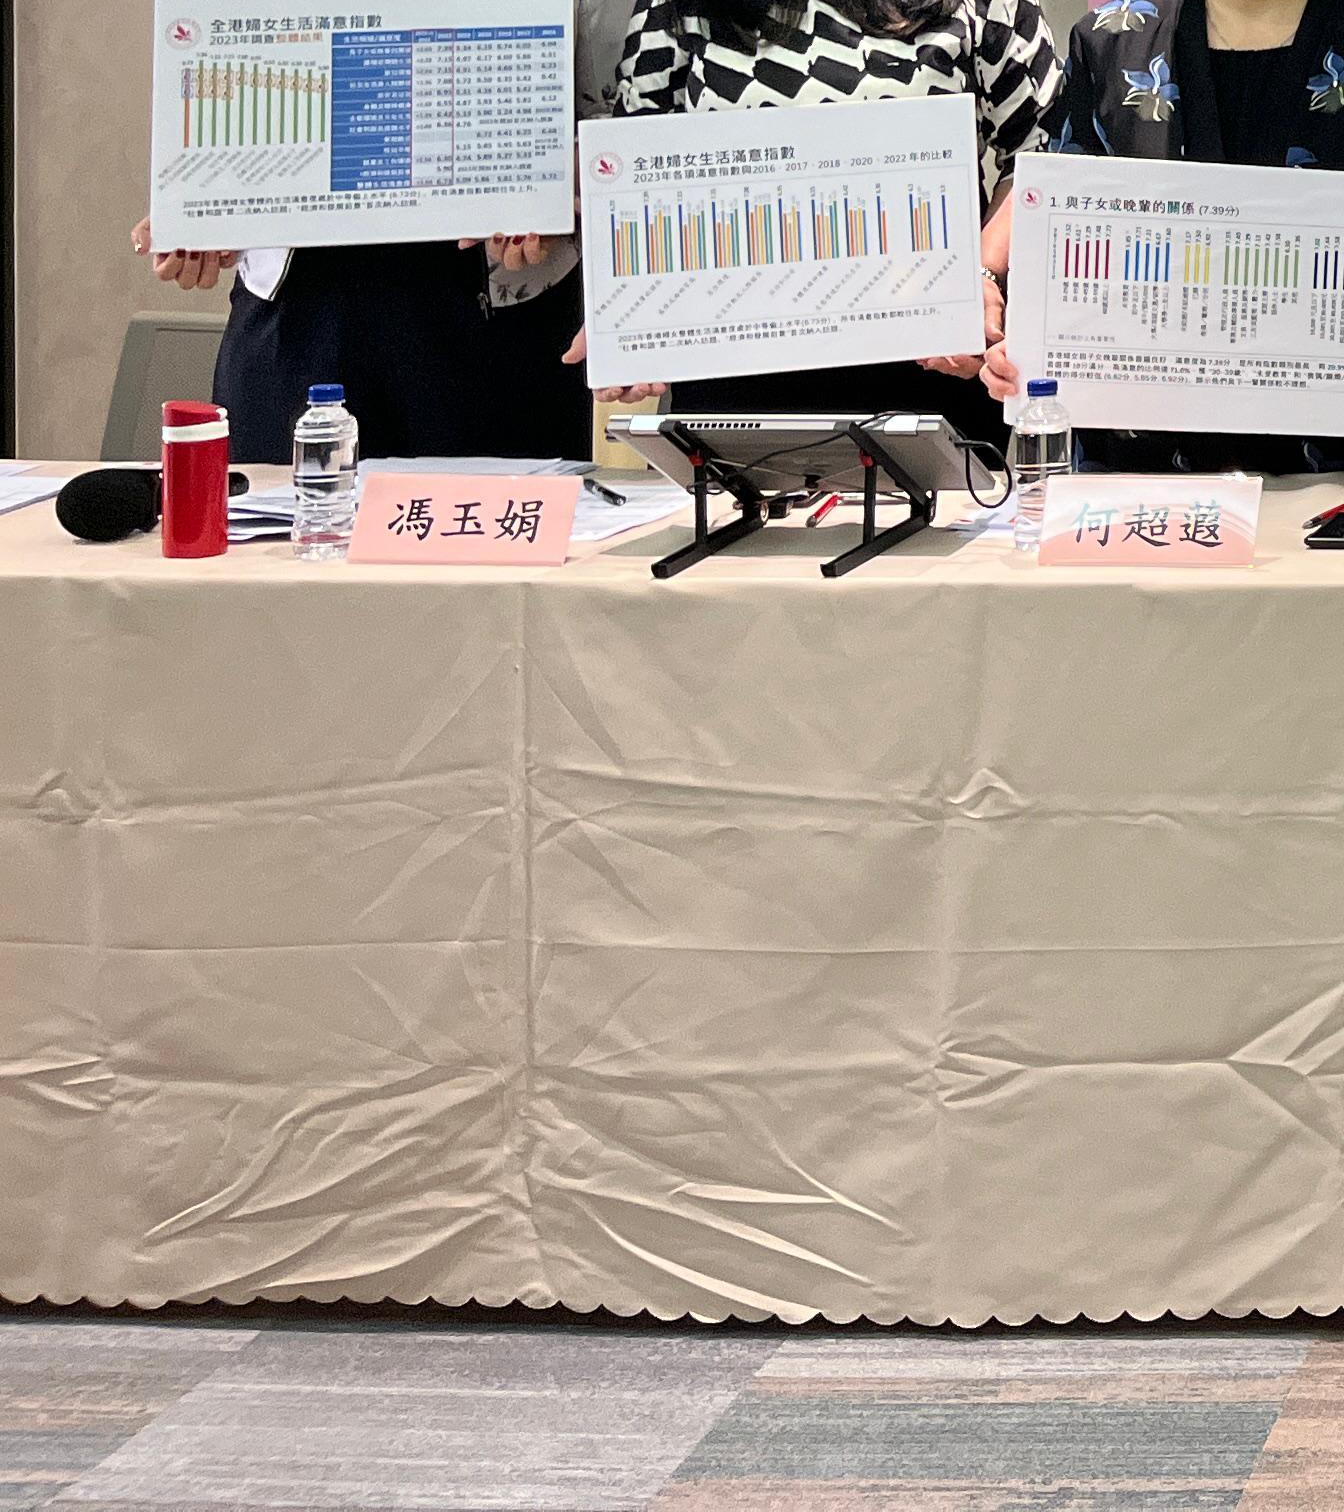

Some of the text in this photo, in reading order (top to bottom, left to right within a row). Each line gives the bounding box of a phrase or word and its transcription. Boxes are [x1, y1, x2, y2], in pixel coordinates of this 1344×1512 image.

[211, 15, 383, 33] 全港婦女生活滿意指數
[633, 145, 796, 171] 全港婦女生活滿意指數
[1065, 196, 1195, 215] 與子女或晚輩的關係
[1199, 205, 1240, 217] (7.39分)
[388, 498, 544, 544] 馮玉娟
